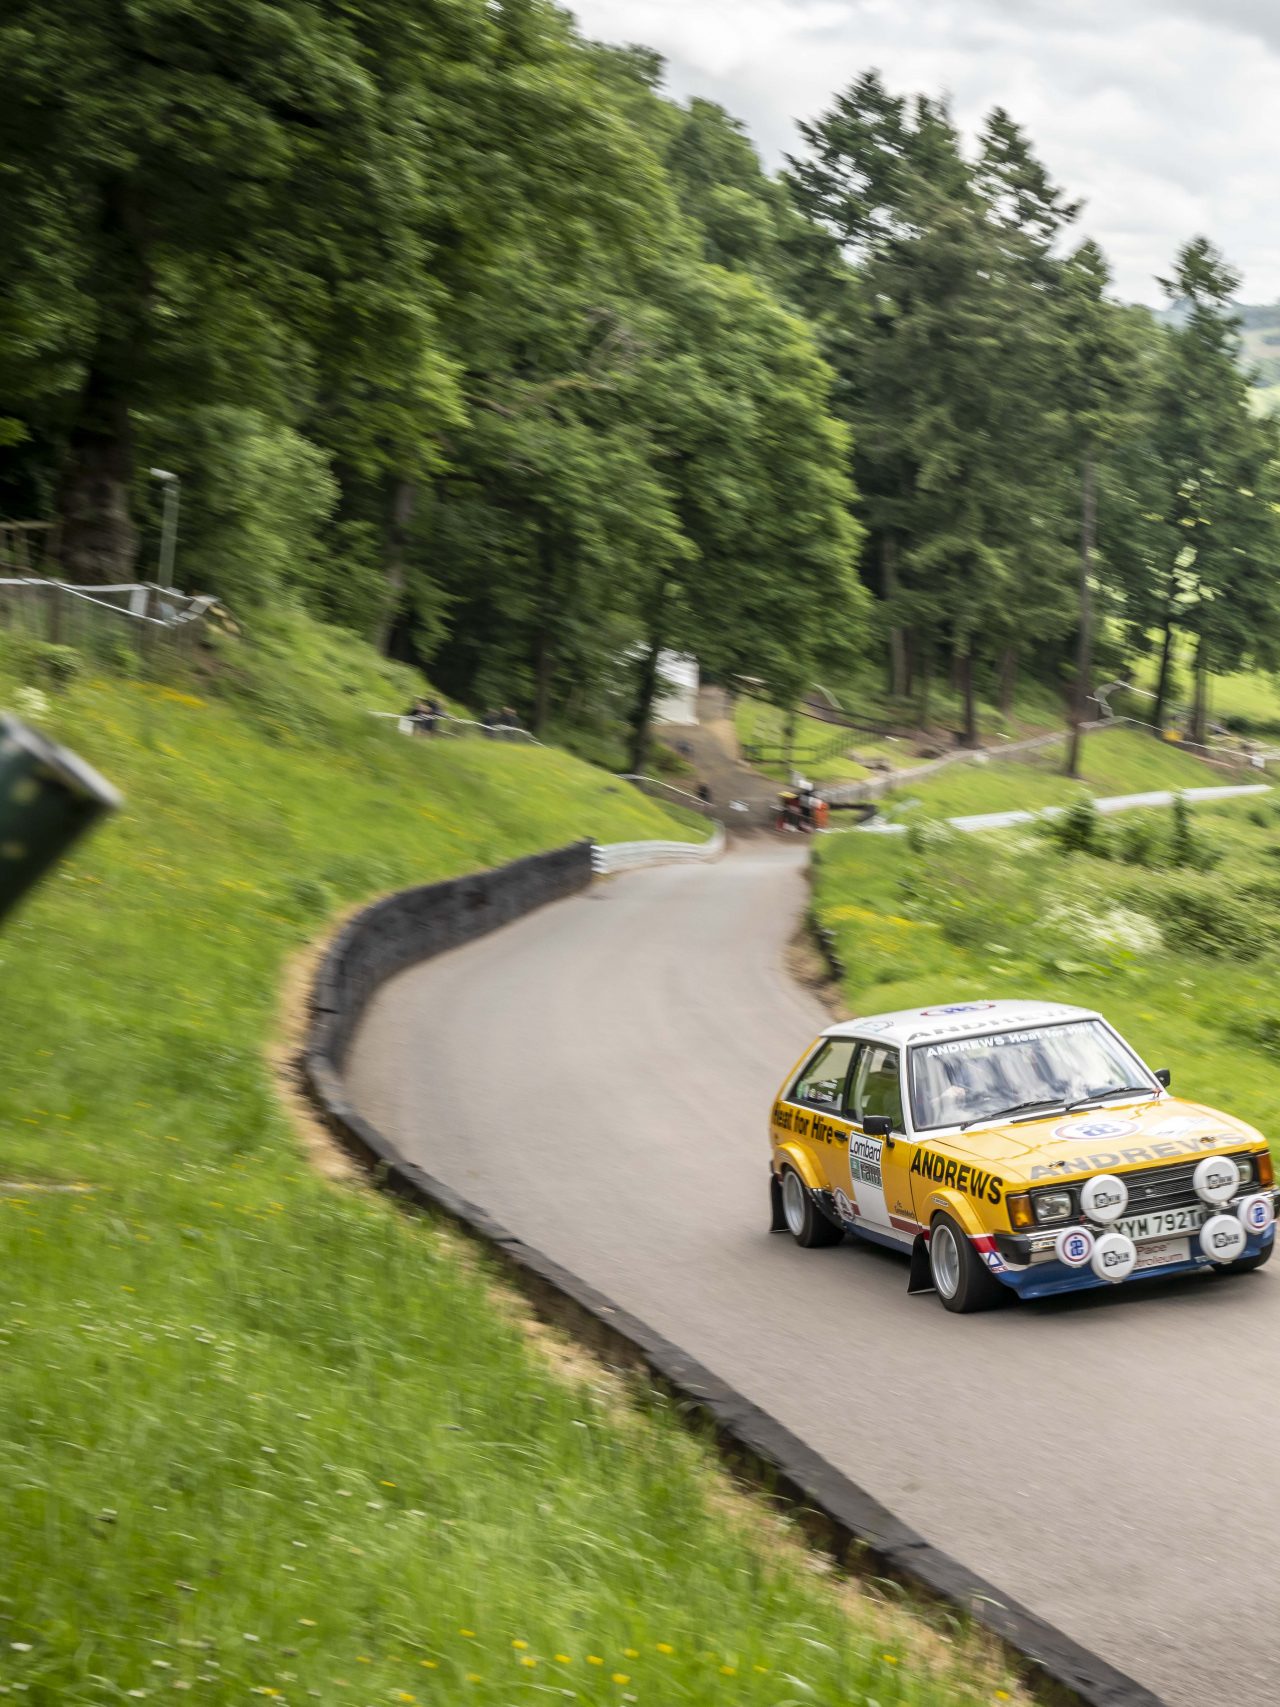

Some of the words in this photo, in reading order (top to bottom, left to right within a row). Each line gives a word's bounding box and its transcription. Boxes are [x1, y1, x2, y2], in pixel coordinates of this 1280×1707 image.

[926, 1036, 1005, 1058] ANDREWS
[1009, 1031, 1041, 1044] Heat
[795, 1109, 809, 1136] for
[811, 1114, 833, 1144] Hire
[850, 1134, 883, 1162] Lombard
[1030, 1133, 1247, 1180] ANDREWS
[910, 1148, 1003, 1205] ANDREWS
[1152, 1209, 1197, 1233] 792T
